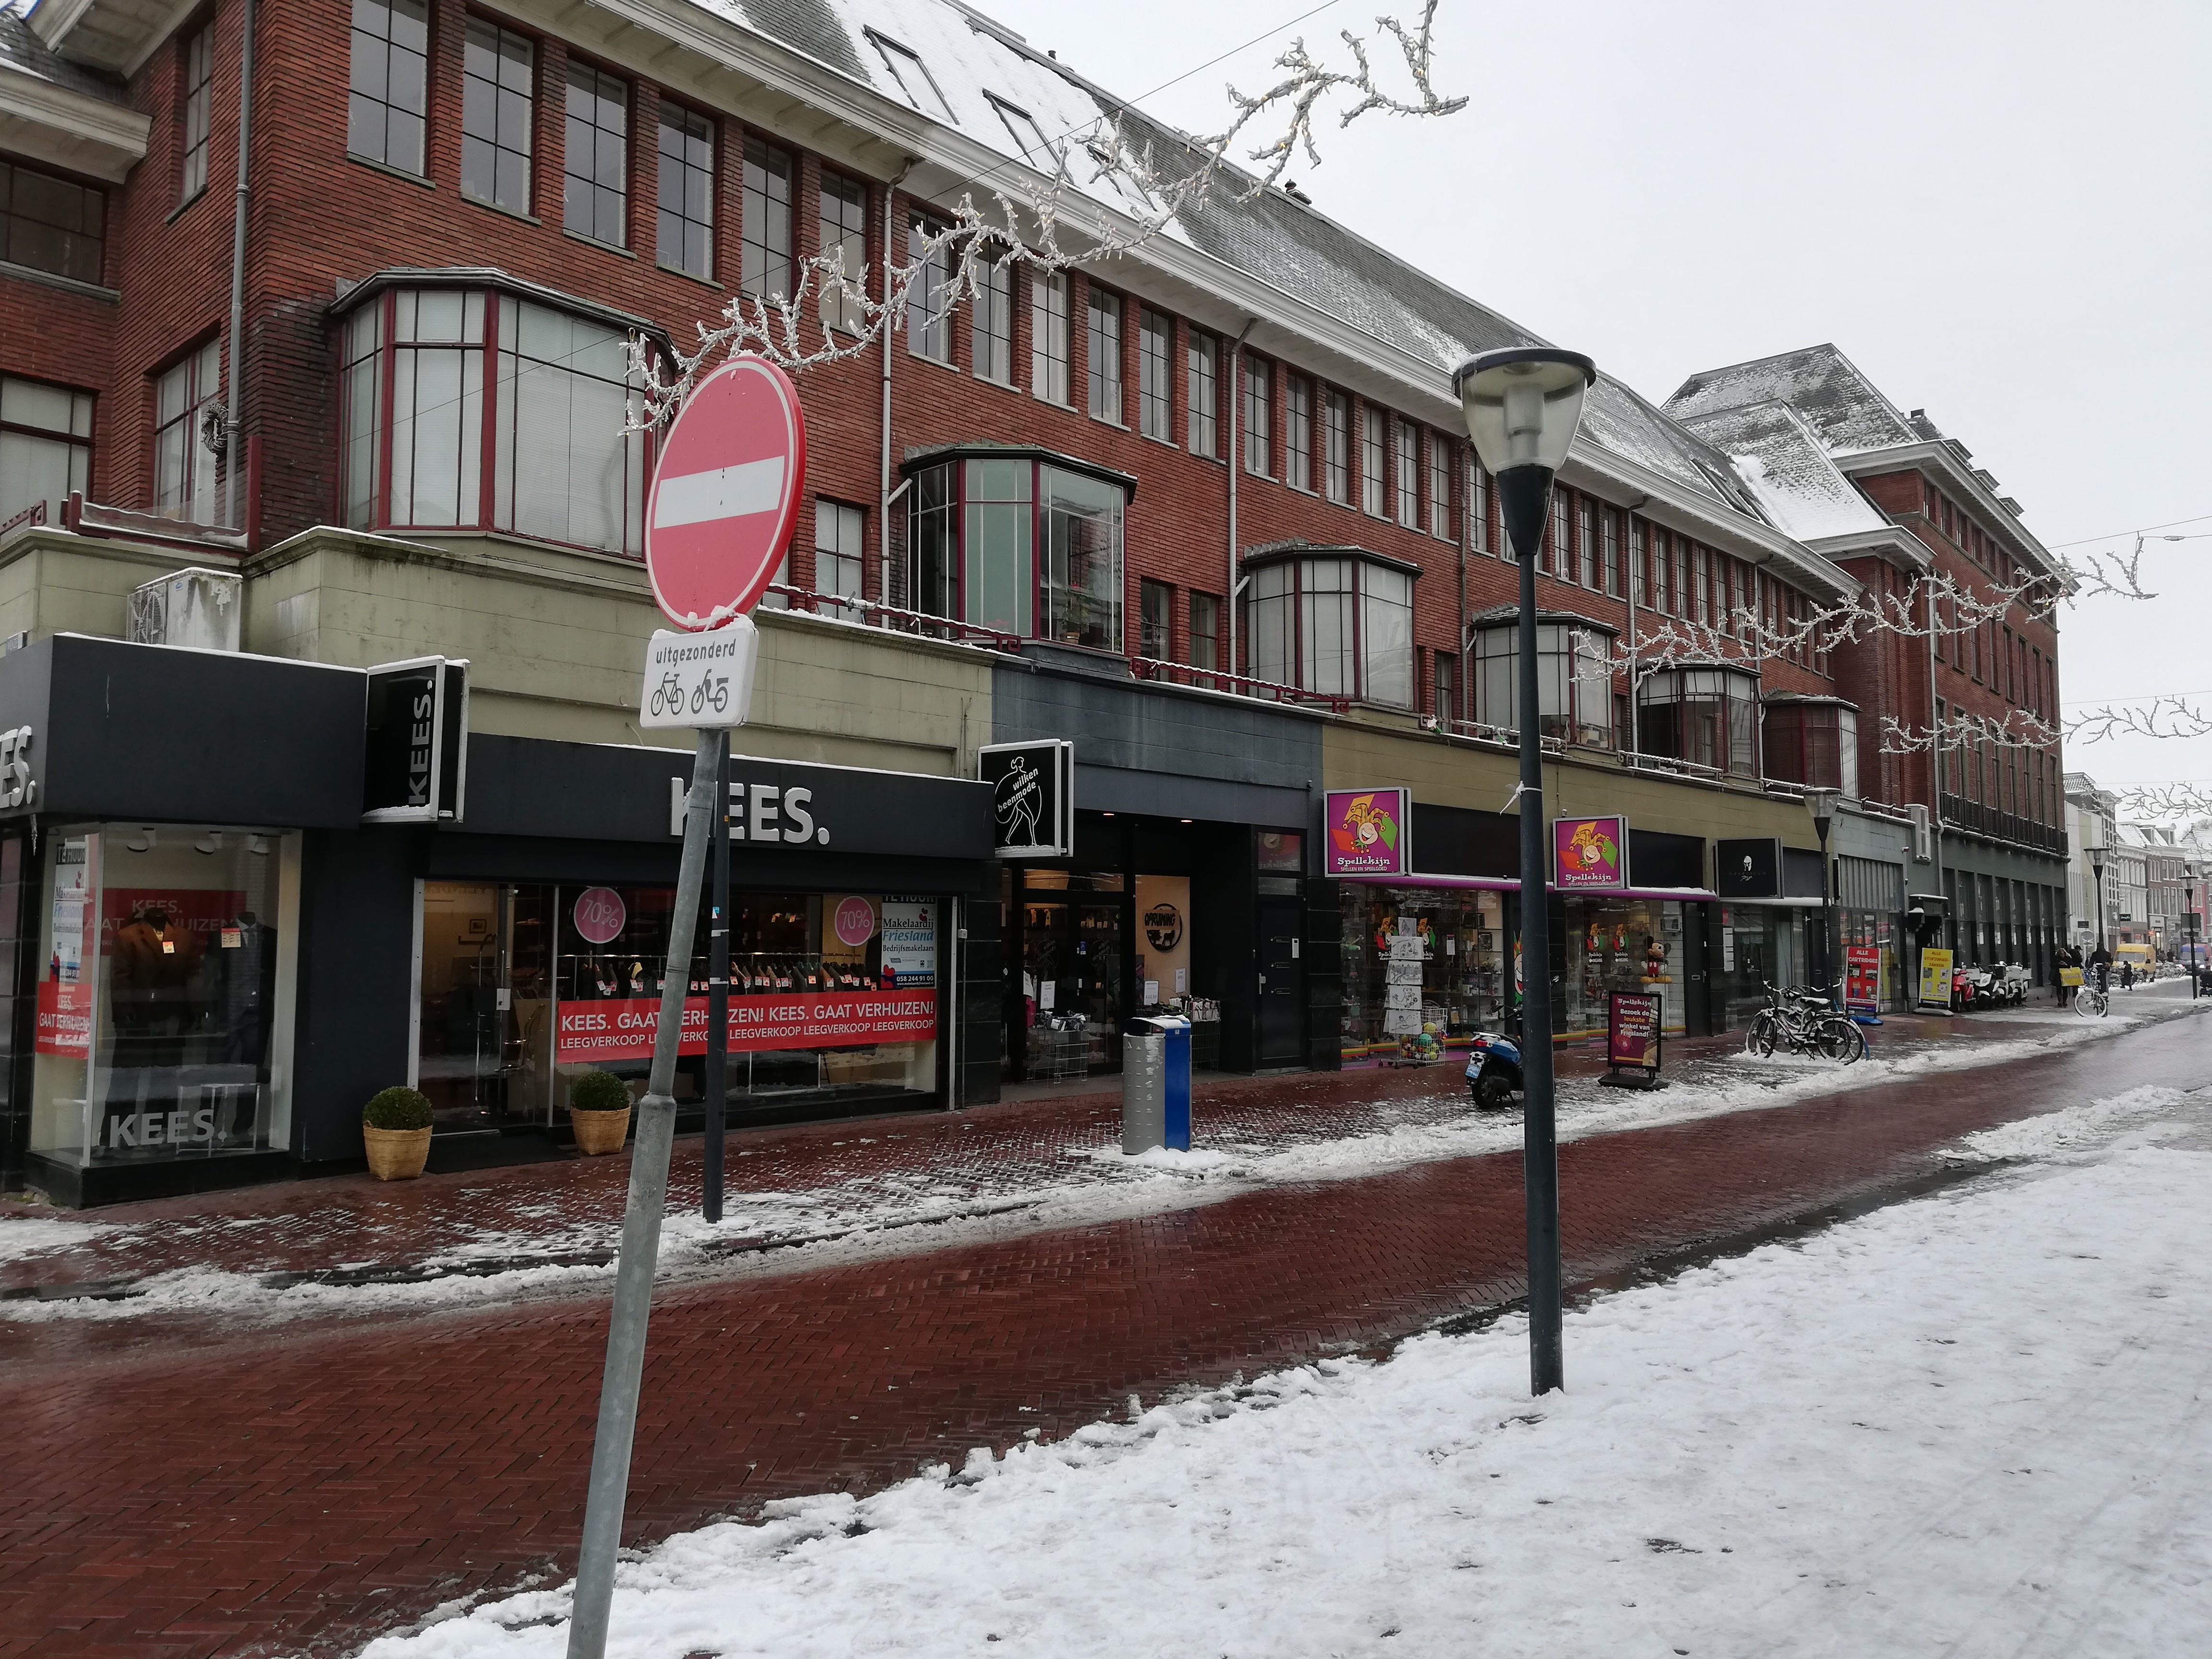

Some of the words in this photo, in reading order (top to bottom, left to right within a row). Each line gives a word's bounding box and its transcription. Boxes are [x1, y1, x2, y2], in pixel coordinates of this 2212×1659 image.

[656, 638, 736, 668] uitgezonderd
[409, 680, 432, 805] KEES.
[1012, 768, 1039, 791] wilken
[998, 781, 1036, 813] beenmode
[1337, 855, 1391, 867] Spellekijn
[1565, 872, 1612, 882] Spellekijn
[582, 899, 618, 928] 70%
[841, 910, 870, 930] 70%
[1144, 912, 1176, 926] OPRUIMING
[883, 918, 934, 930] Makelaardij
[882, 929, 934, 941] Friesland
[883, 944, 934, 954] Bedrijfsmakelaars
[1618, 998, 1652, 1007] Spellekijn
[39, 1012, 57, 1028] GAAT
[562, 1013, 612, 1032] KEES.
[617, 1011, 660, 1029] GAAT
[769, 1006, 809, 1022] KEES.
[814, 1004, 853, 1019] GAAT
[856, 1000, 934, 1017] VERHUIZEN!
[561, 1034, 645, 1049] LEEGVERKOOP
[729, 1026, 801, 1040] LEEGVERKOOP
[804, 1022, 870, 1035] LEEGVERKOOP
[873, 1019, 934, 1032] LEEGVERKOOP
[1620, 1029, 1648, 1037] Friesland!
[109, 1108, 228, 1148] KEES.
